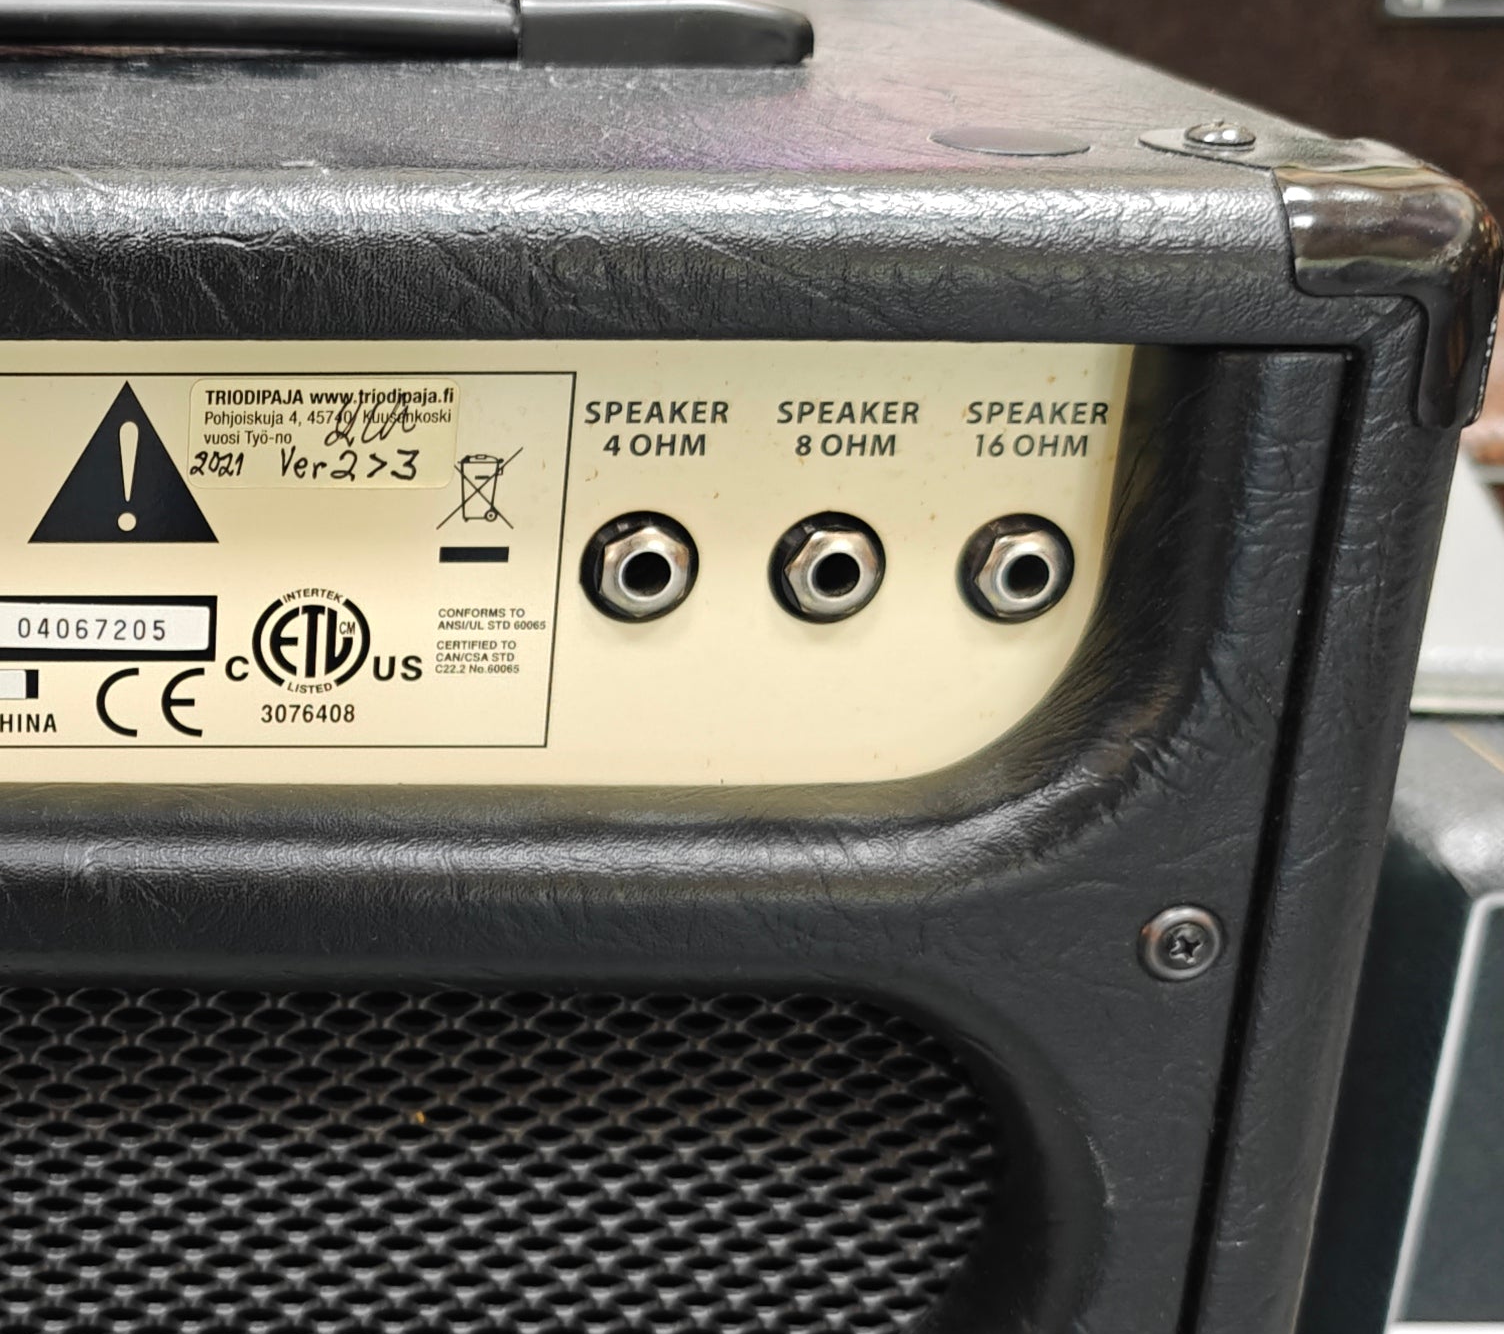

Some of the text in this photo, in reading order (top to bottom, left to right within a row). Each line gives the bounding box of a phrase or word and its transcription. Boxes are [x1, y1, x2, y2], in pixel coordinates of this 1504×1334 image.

[205, 388, 454, 406] TRIODIPAJA www.triodipaja.fi
[204, 410, 284, 429] Pohjoiskuja
[289, 411, 302, 427] 4,
[584, 400, 729, 424] SPEAKER
[776, 400, 920, 424] SPEAKER
[966, 401, 1109, 425] SPEAKER
[204, 430, 293, 448] vuosi Työ-no
[603, 433, 706, 457] 4 OHM
[795, 433, 897, 457] 8 OHM
[976, 434, 1089, 458] 16 OHM
[189, 450, 245, 477] 2021
[282, 588, 344, 603] INTERTEK
[438, 608, 526, 618] CONFORMS TO
[17, 617, 166, 642] 04067205
[339, 621, 356, 635] CM
[437, 620, 546, 631] ANSI/UL STD 60065
[269, 604, 354, 679] ETL
[436, 640, 517, 651] CERTIFIED TO
[435, 652, 515, 663] CAN/CSA STD
[372, 655, 423, 682] US
[435, 664, 466, 674] C22.2
[286, 682, 333, 694] LISTED
[261, 703, 355, 724] 3076408
